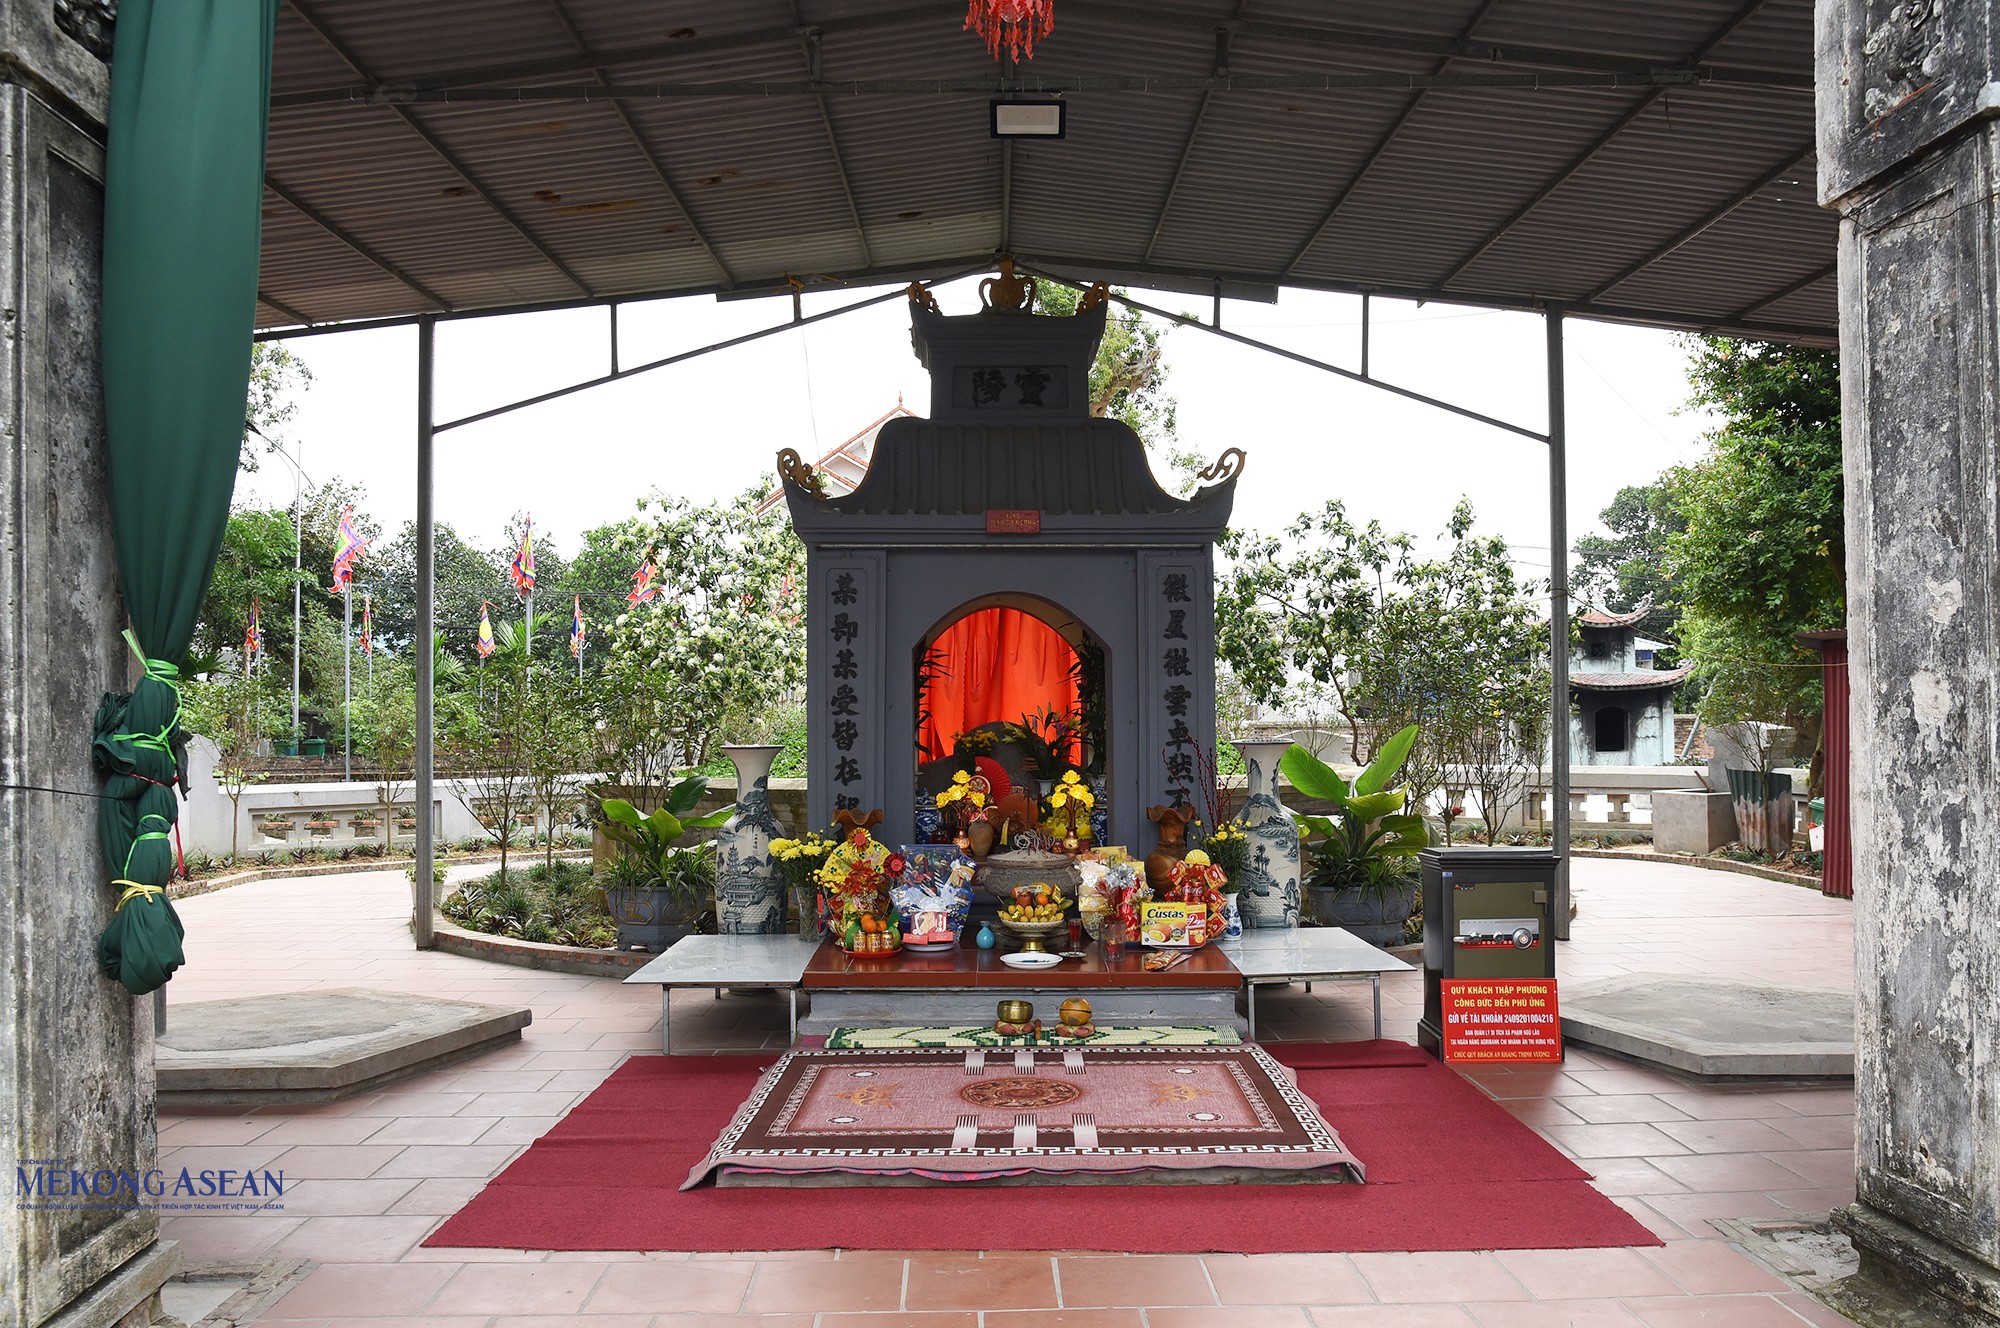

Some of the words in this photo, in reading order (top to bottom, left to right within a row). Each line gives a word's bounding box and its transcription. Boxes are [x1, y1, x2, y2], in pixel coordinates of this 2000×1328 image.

[1147, 909, 1184, 919] Custas
[1451, 985, 1465, 996] QUÝ
[1468, 985, 1493, 994] KHÁCH
[1495, 985, 1514, 996] THẬP
[1517, 985, 1548, 994] PHƯƠNG
[1454, 998, 1475, 1007] CÔNG
[1477, 997, 1493, 1007] ĐỨC
[1512, 998, 1527, 1007] PHÙ
[1530, 996, 1545, 1007] ỦNG
[1470, 1012, 1480, 1024] TÀI
[1481, 1011, 1503, 1024] KHOẢN
